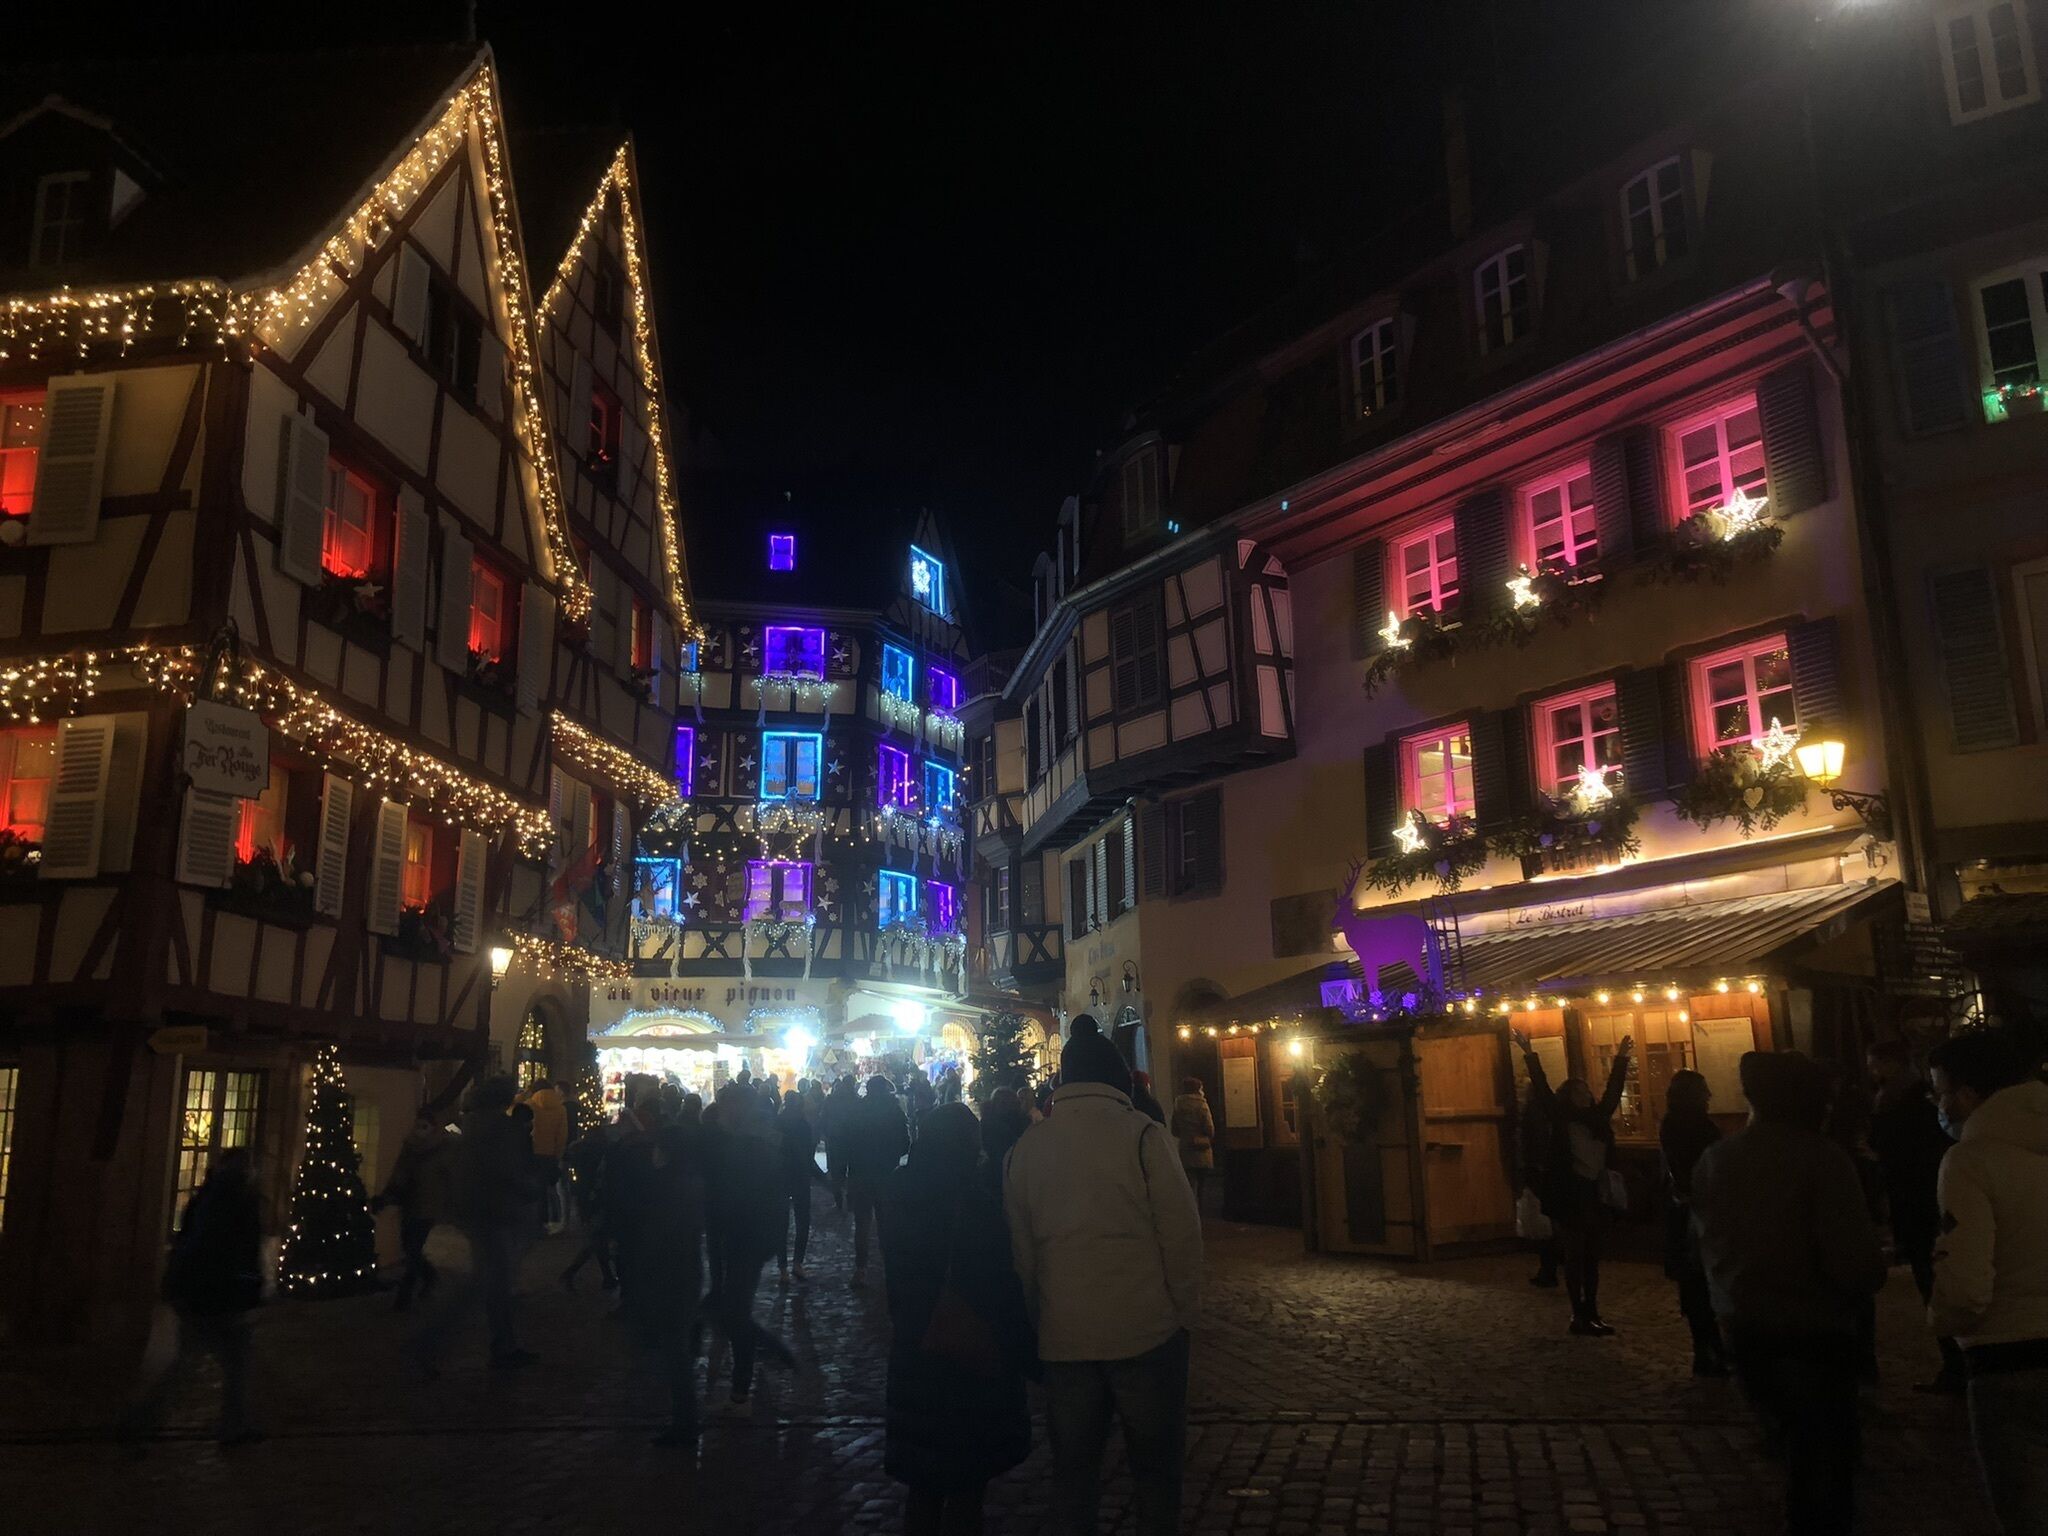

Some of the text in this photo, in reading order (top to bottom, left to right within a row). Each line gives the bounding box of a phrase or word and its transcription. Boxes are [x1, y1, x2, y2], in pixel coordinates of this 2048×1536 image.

[188, 740, 261, 781] Fer Rouge
[1516, 905, 1584, 924] Le Bistrot
[607, 985, 631, 1001] au
[726, 982, 796, 1007] pignon
